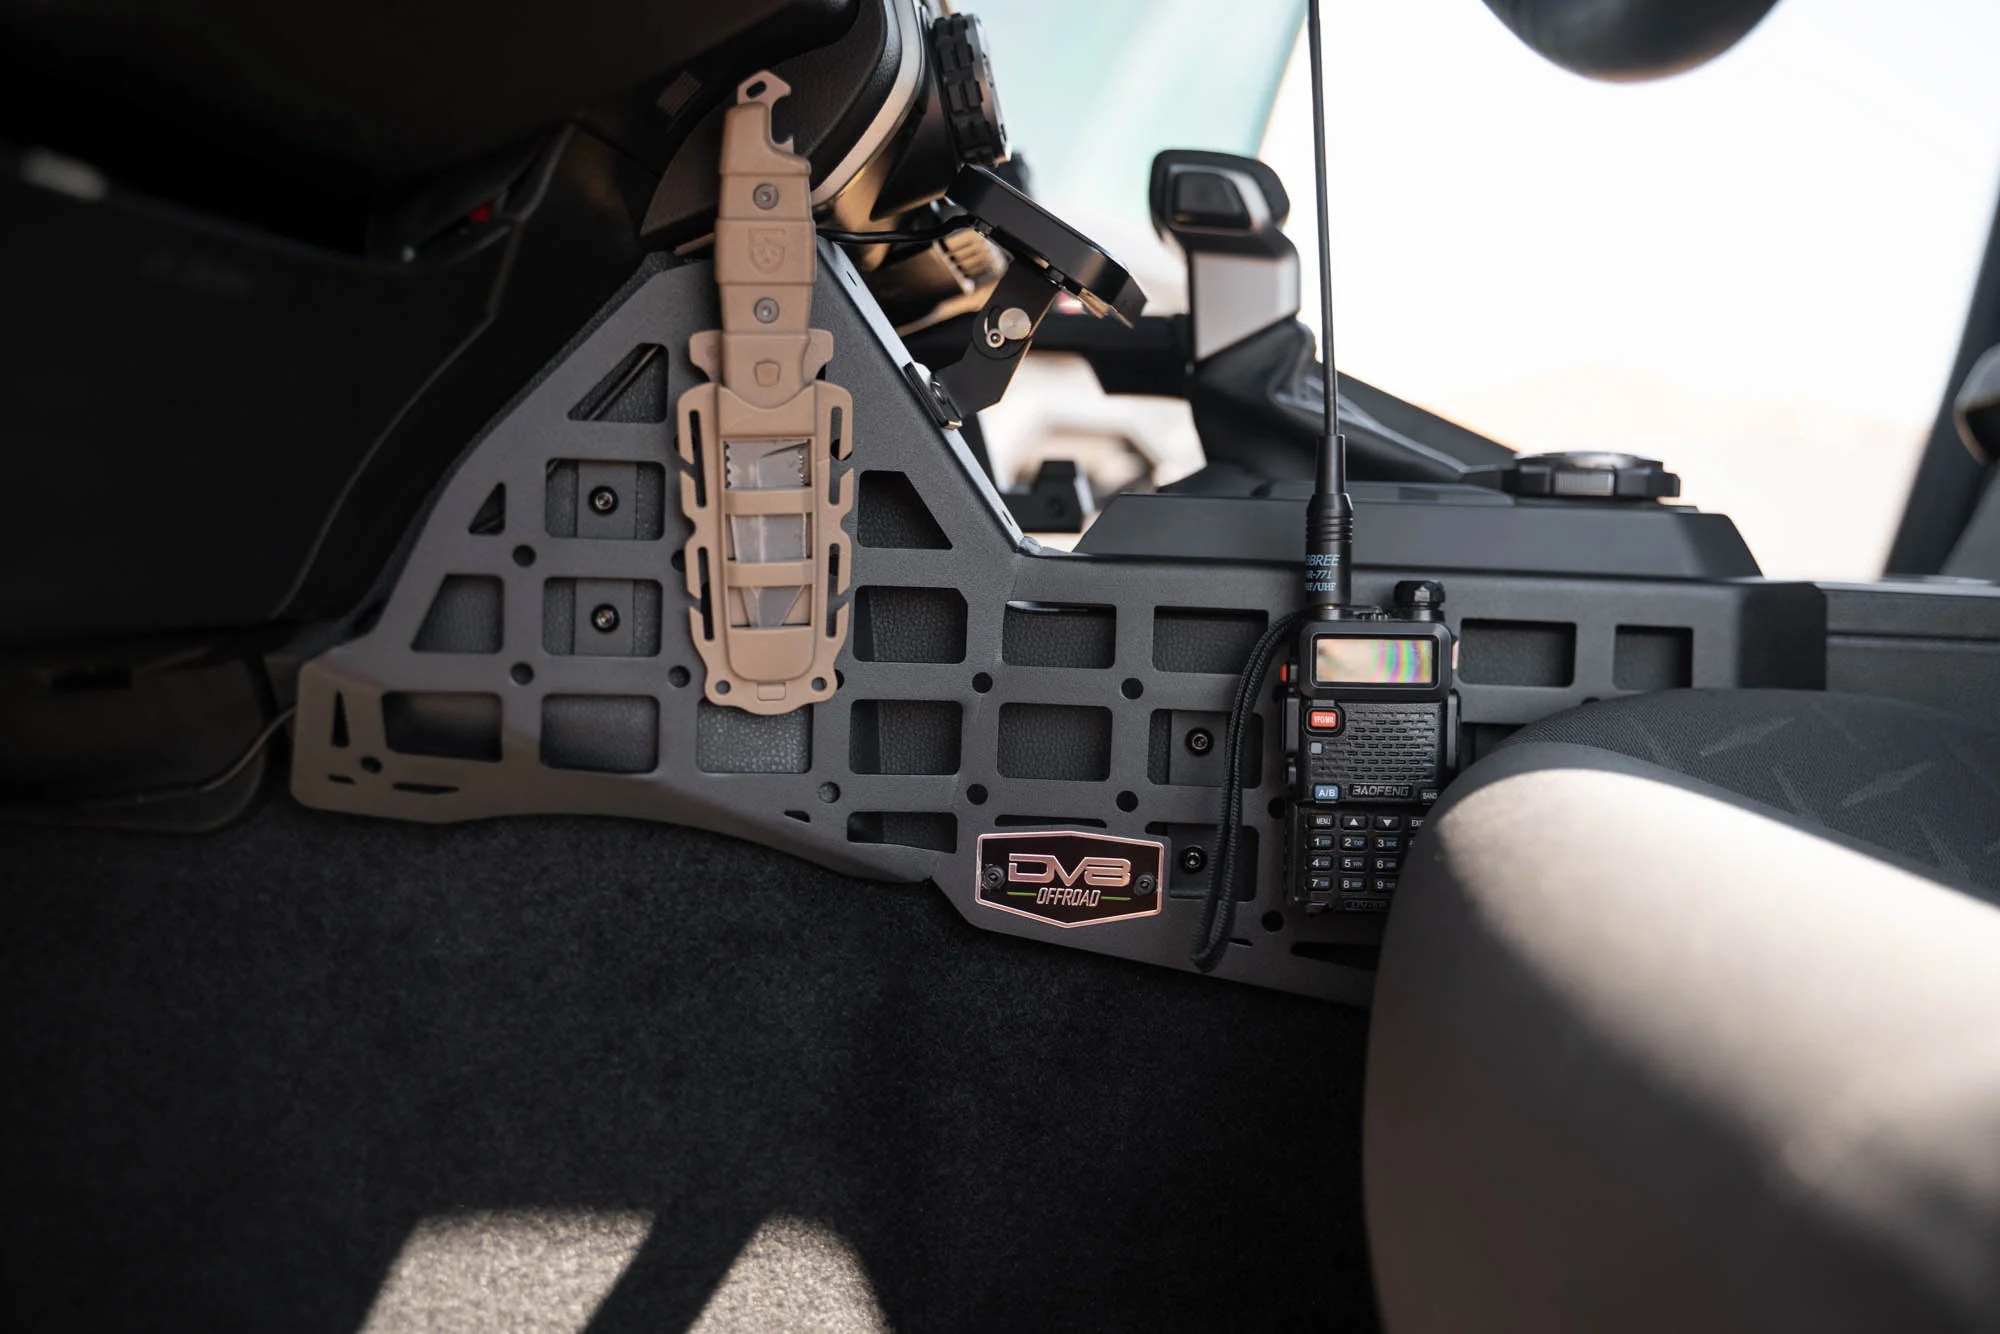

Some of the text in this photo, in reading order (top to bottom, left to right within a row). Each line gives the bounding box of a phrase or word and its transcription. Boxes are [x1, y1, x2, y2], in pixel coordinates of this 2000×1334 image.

[1318, 788, 1336, 797] A/B
[1352, 785, 1409, 797] BAOFENG
[1422, 792, 1438, 800] BAND
[1314, 838, 1320, 846] 1
[1344, 838, 1352, 847] 2
[1378, 839, 1385, 848] 3
[1312, 859, 1320, 867] 4
[1344, 859, 1351, 868] 5
[1377, 860, 1384, 869] 6
[1008, 853, 1132, 887] DV8
[1312, 879, 1319, 888] 7
[1343, 880, 1350, 889] 8
[1377, 881, 1384, 889] 9
[1036, 887, 1102, 907] OFFROAD
